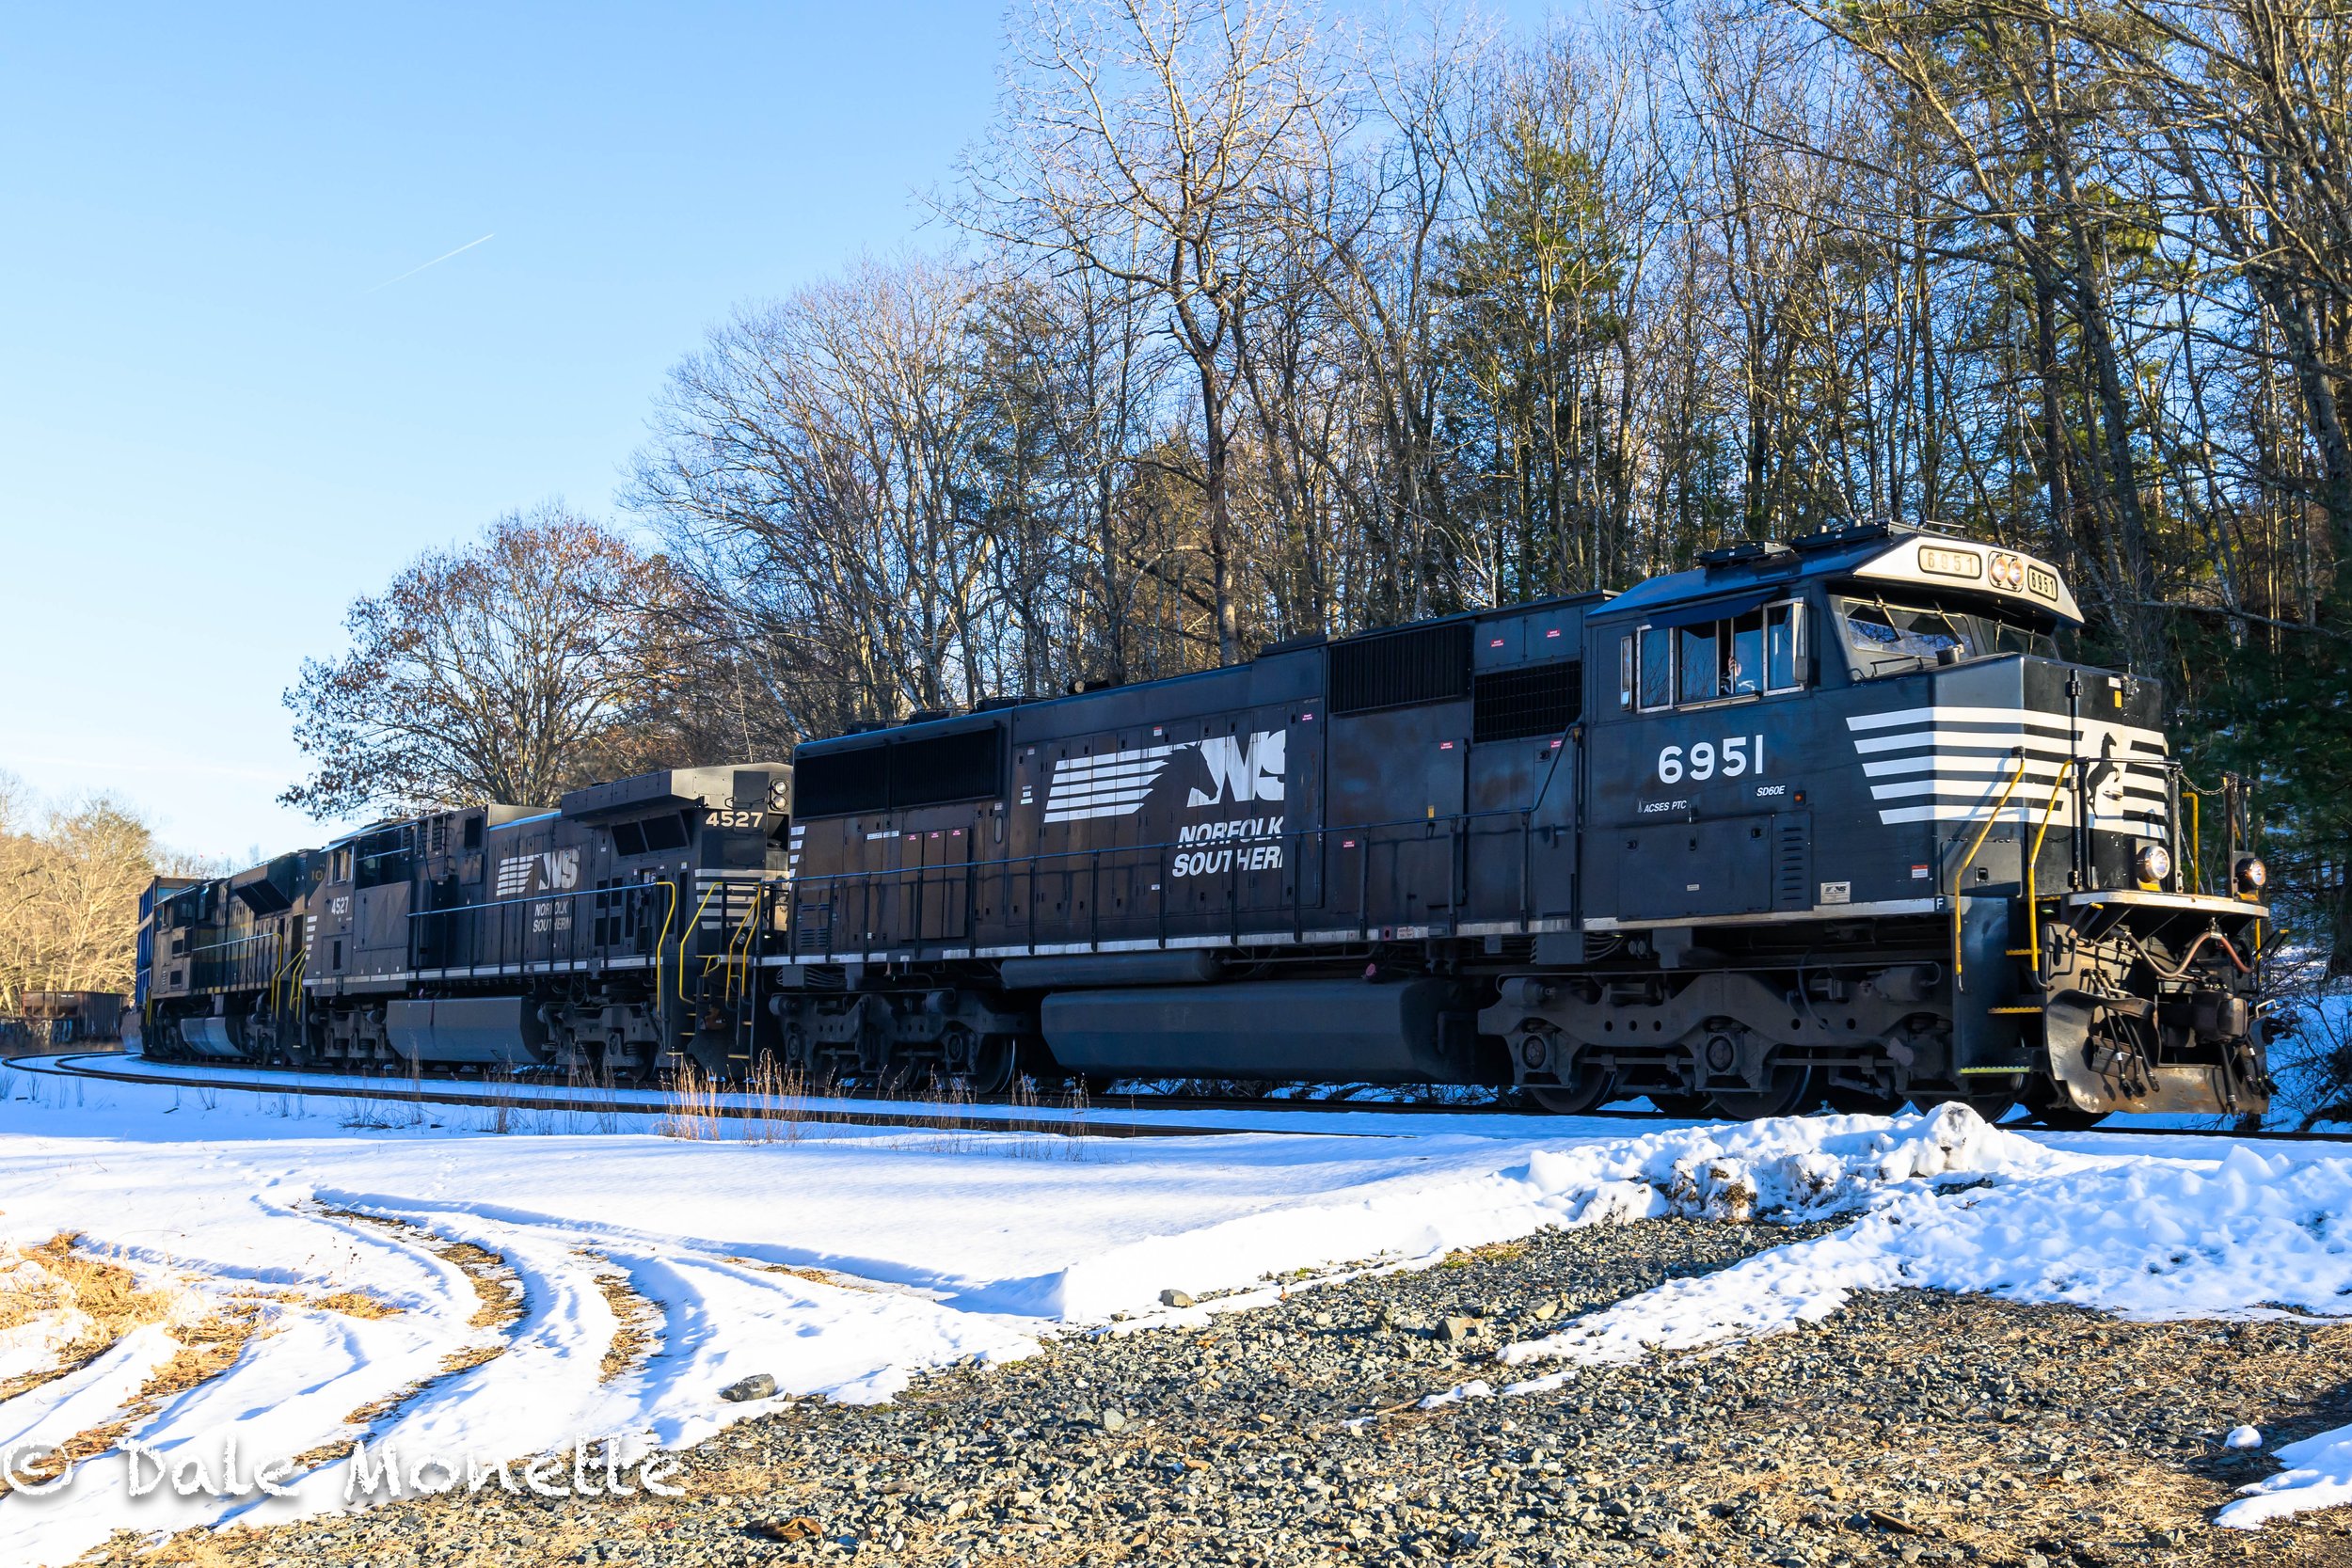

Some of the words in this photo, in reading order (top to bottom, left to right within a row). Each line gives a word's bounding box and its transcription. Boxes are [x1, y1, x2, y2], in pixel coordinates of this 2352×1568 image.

[1928, 546, 1974, 574] 6951
[2031, 571, 2055, 596] 6951
[1658, 734, 1764, 784] 6951
[1756, 784, 1786, 797] SD60E
[1644, 801, 1670, 814] ACSES
[1671, 800, 1688, 811] PTC
[705, 811, 764, 828] 4527
[1177, 816, 1284, 849] NORFOLK
[1172, 846, 1283, 878] SOUTHER
[331, 895, 349, 915] 4527
[1936, 897, 1944, 910] F
